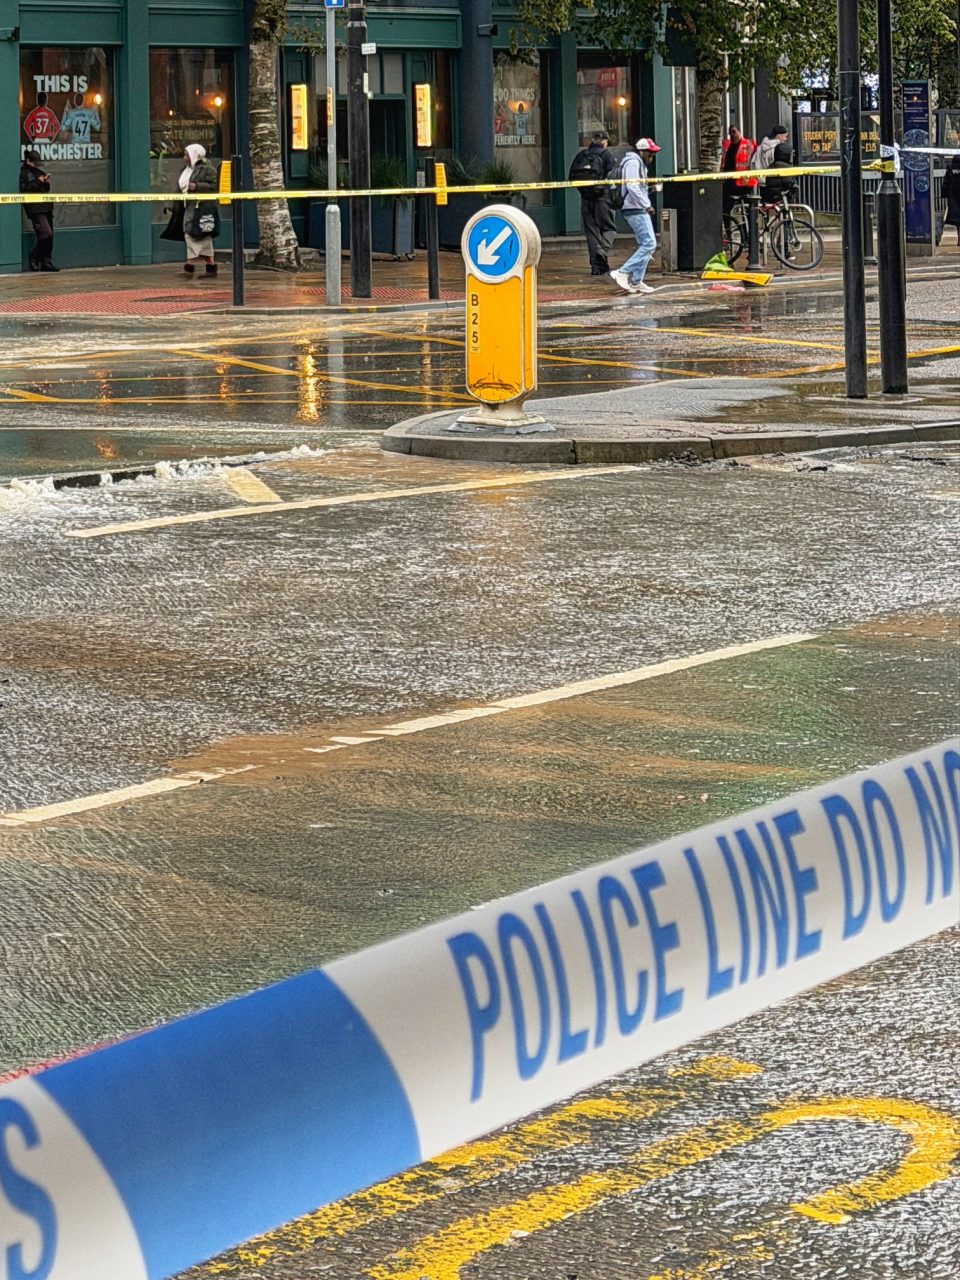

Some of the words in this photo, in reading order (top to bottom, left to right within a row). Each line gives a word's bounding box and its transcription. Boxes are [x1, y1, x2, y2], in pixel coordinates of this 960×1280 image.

[33, 75, 70, 93] THIS
[73, 75, 89, 93] IS
[35, 118, 49, 134] 37
[75, 120, 88, 136] 47
[446, 861, 684, 1103] POLICE
[683, 809, 823, 999] LINE
[820, 778, 907, 940] DO
